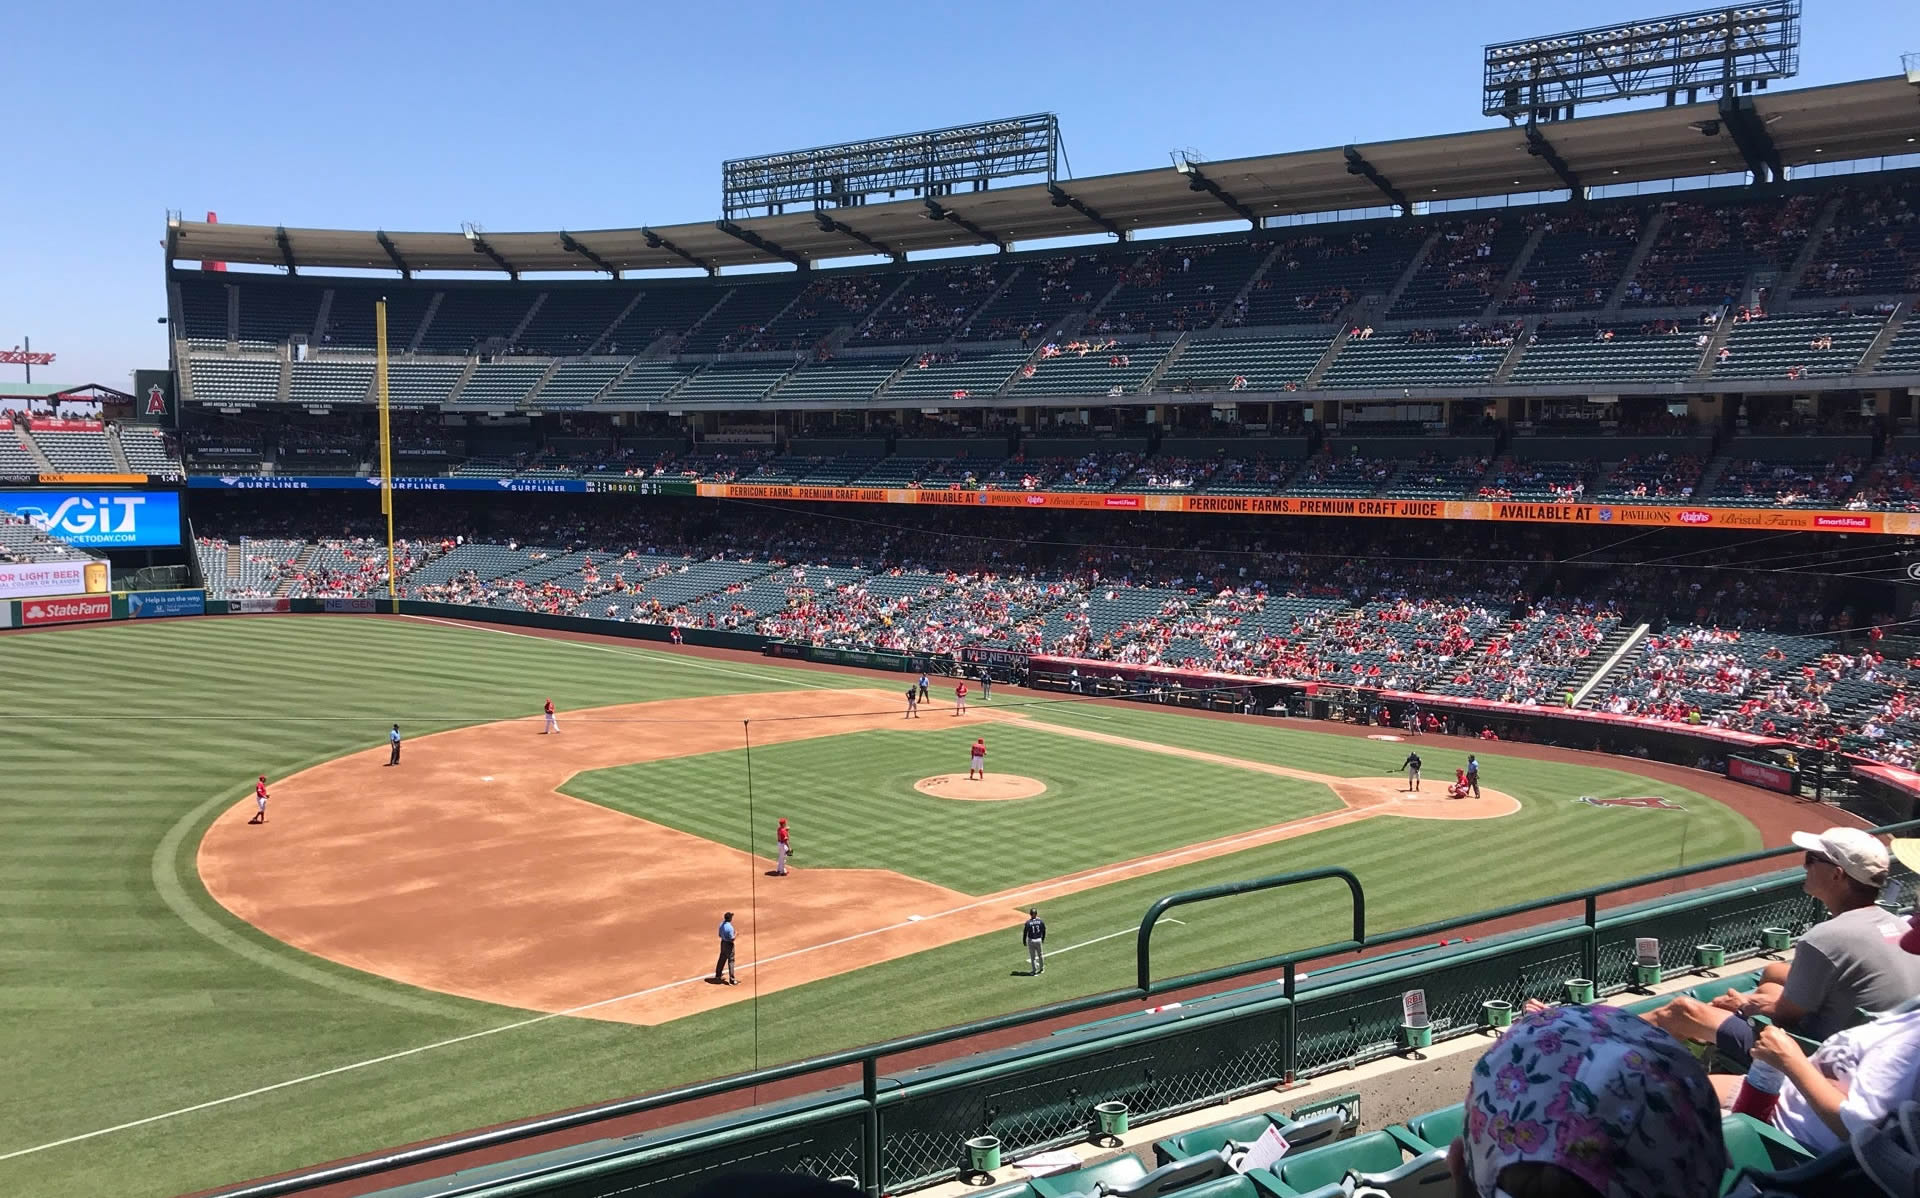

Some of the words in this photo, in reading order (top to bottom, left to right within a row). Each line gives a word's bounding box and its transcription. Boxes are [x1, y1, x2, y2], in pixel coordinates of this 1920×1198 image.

[730, 486, 767, 496] PERRICONE
[836, 489, 858, 499] CRAFT
[862, 490, 884, 500] JUICE
[920, 492, 962, 503] AVAILABLE
[965, 493, 976, 503] AT
[1189, 498, 1249, 511] PERRICONE
[1359, 503, 1396, 515] CRAFT
[1401, 503, 1437, 516] JUICE
[1500, 505, 1570, 520] AVAILABLE
[1575, 507, 1593, 520] AT
[1620, 510, 1671, 522] PAVILIONS
[1680, 511, 1709, 522] Ralphs
[1720, 513, 1762, 525] Bristol
[1764, 514, 1807, 527] Farms
[1817, 517, 1866, 527] Smart&Final
[19, 572, 50, 581] LIGHT
[53, 570, 80, 579] BEER
[145, 596, 160, 604] Help
